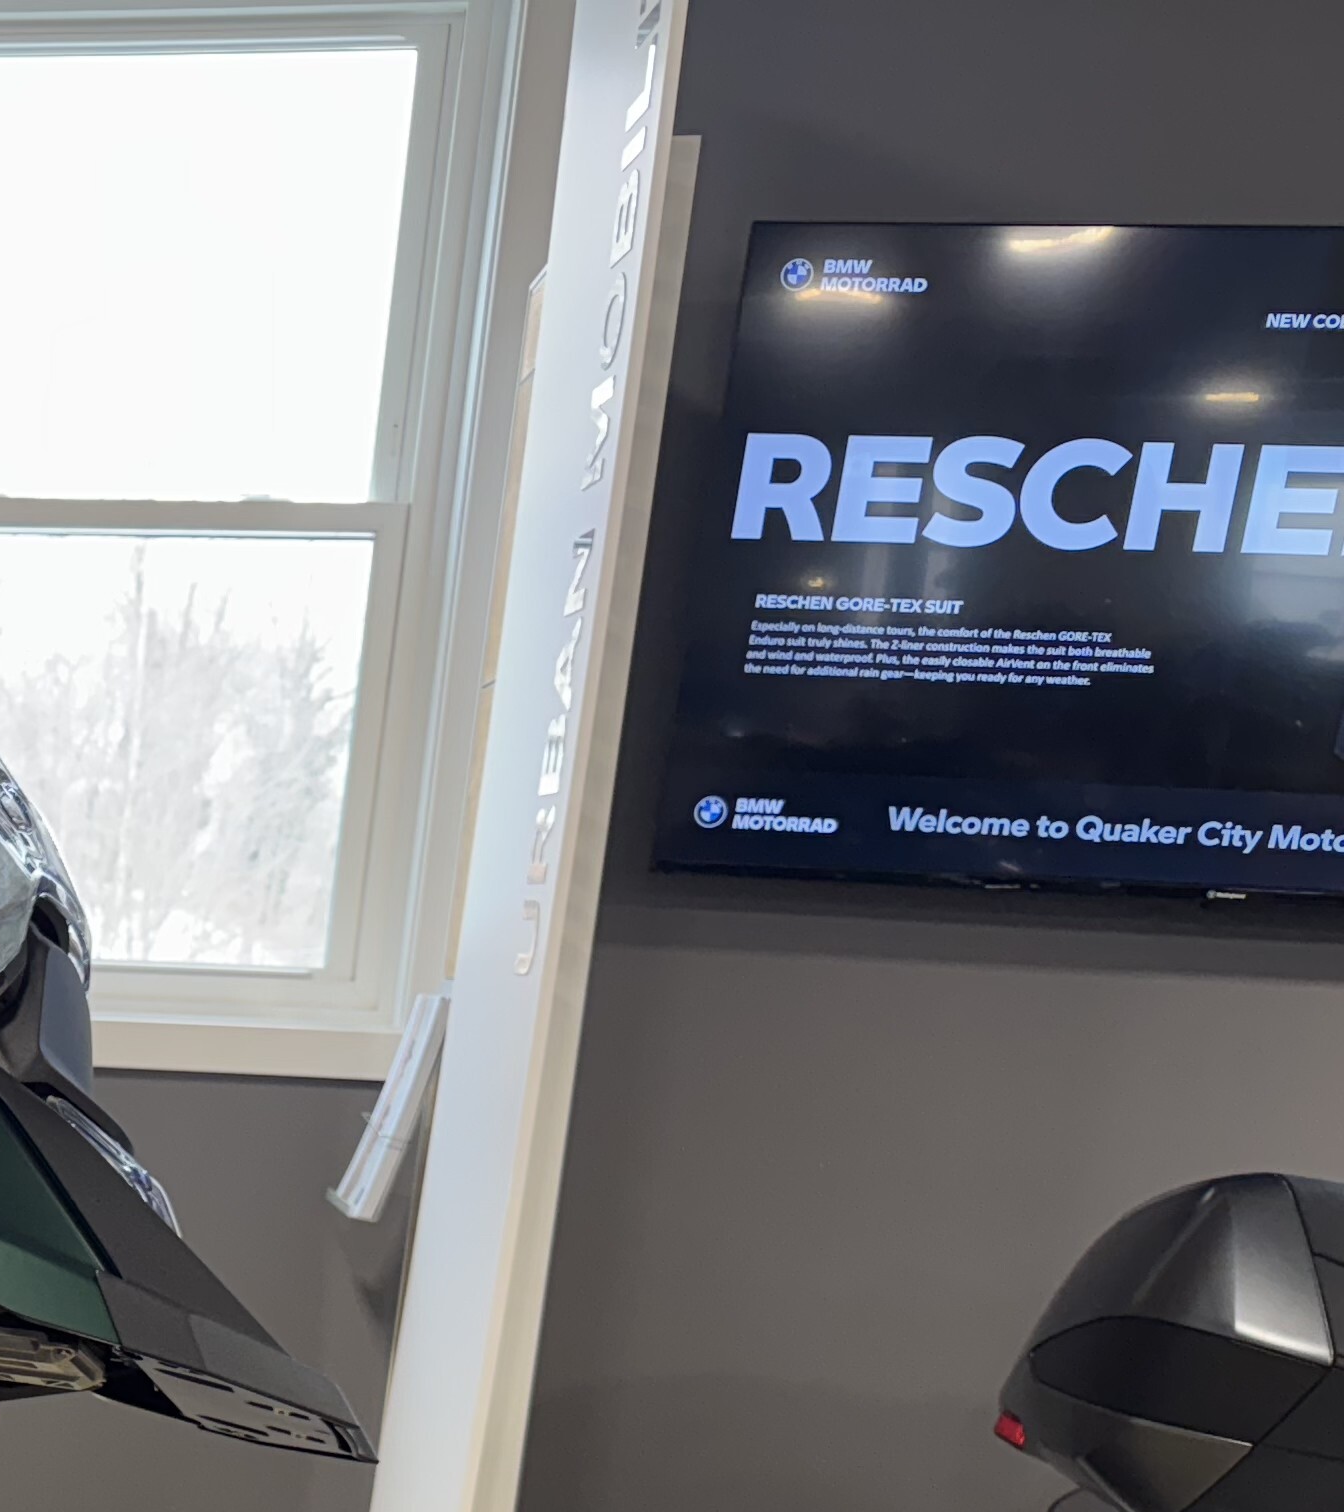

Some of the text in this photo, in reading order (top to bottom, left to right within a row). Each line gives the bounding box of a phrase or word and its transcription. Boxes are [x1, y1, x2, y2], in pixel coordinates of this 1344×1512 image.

[823, 259, 873, 274] BMW
[820, 277, 928, 293] MOTORRAD
[1265, 313, 1344, 329] NEW CO
[731, 432, 1344, 555] RESCHE
[755, 594, 964, 614] RESCHEN GORE-TEX SUIT
[751, 620, 800, 634] Especially
[801, 623, 816, 632] on
[816, 622, 885, 636] long-distance
[917, 626, 936, 637] the
[937, 627, 979, 638] comfort
[980, 628, 994, 638] of
[993, 629, 1012, 639] the
[1013, 629, 1056, 641] Reschen
[1058, 631, 1112, 643] GORE-TEX
[748, 635, 785, 646] Enduro
[786, 636, 806, 646] suit
[807, 636, 832, 649] truly
[870, 638, 889, 650] The
[925, 640, 990, 653] construction
[991, 643, 1025, 655] makes
[1027, 645, 1045, 655] the
[1046, 645, 1066, 656] suit
[1067, 646, 1093, 657] both
[1094, 647, 1152, 660] breathable
[746, 650, 766, 660] and
[767, 650, 793, 661] wind
[794, 651, 814, 661] and
[902, 654, 920, 664] the
[921, 655, 951, 668] easily
[1036, 661, 1051, 670] on
[1052, 660, 1071, 671] the
[1072, 661, 1099, 672] front
[1100, 663, 1154, 674] eliminates
[744, 663, 762, 673] the
[763, 664, 790, 675] need
[791, 665, 806, 675] for
[807, 665, 858, 677] additional
[859, 667, 880, 678] rain
[955, 672, 976, 683] you
[977, 672, 1007, 684] ready
[1008, 673, 1024, 683] for
[1025, 675, 1045, 686] any
[734, 797, 785, 815] BMW
[731, 814, 840, 833] MOTORRAD
[888, 805, 1030, 838] Welcome
[1036, 815, 1067, 839] to
[1075, 814, 1193, 845] Quaker
[1198, 820, 1263, 854] City
